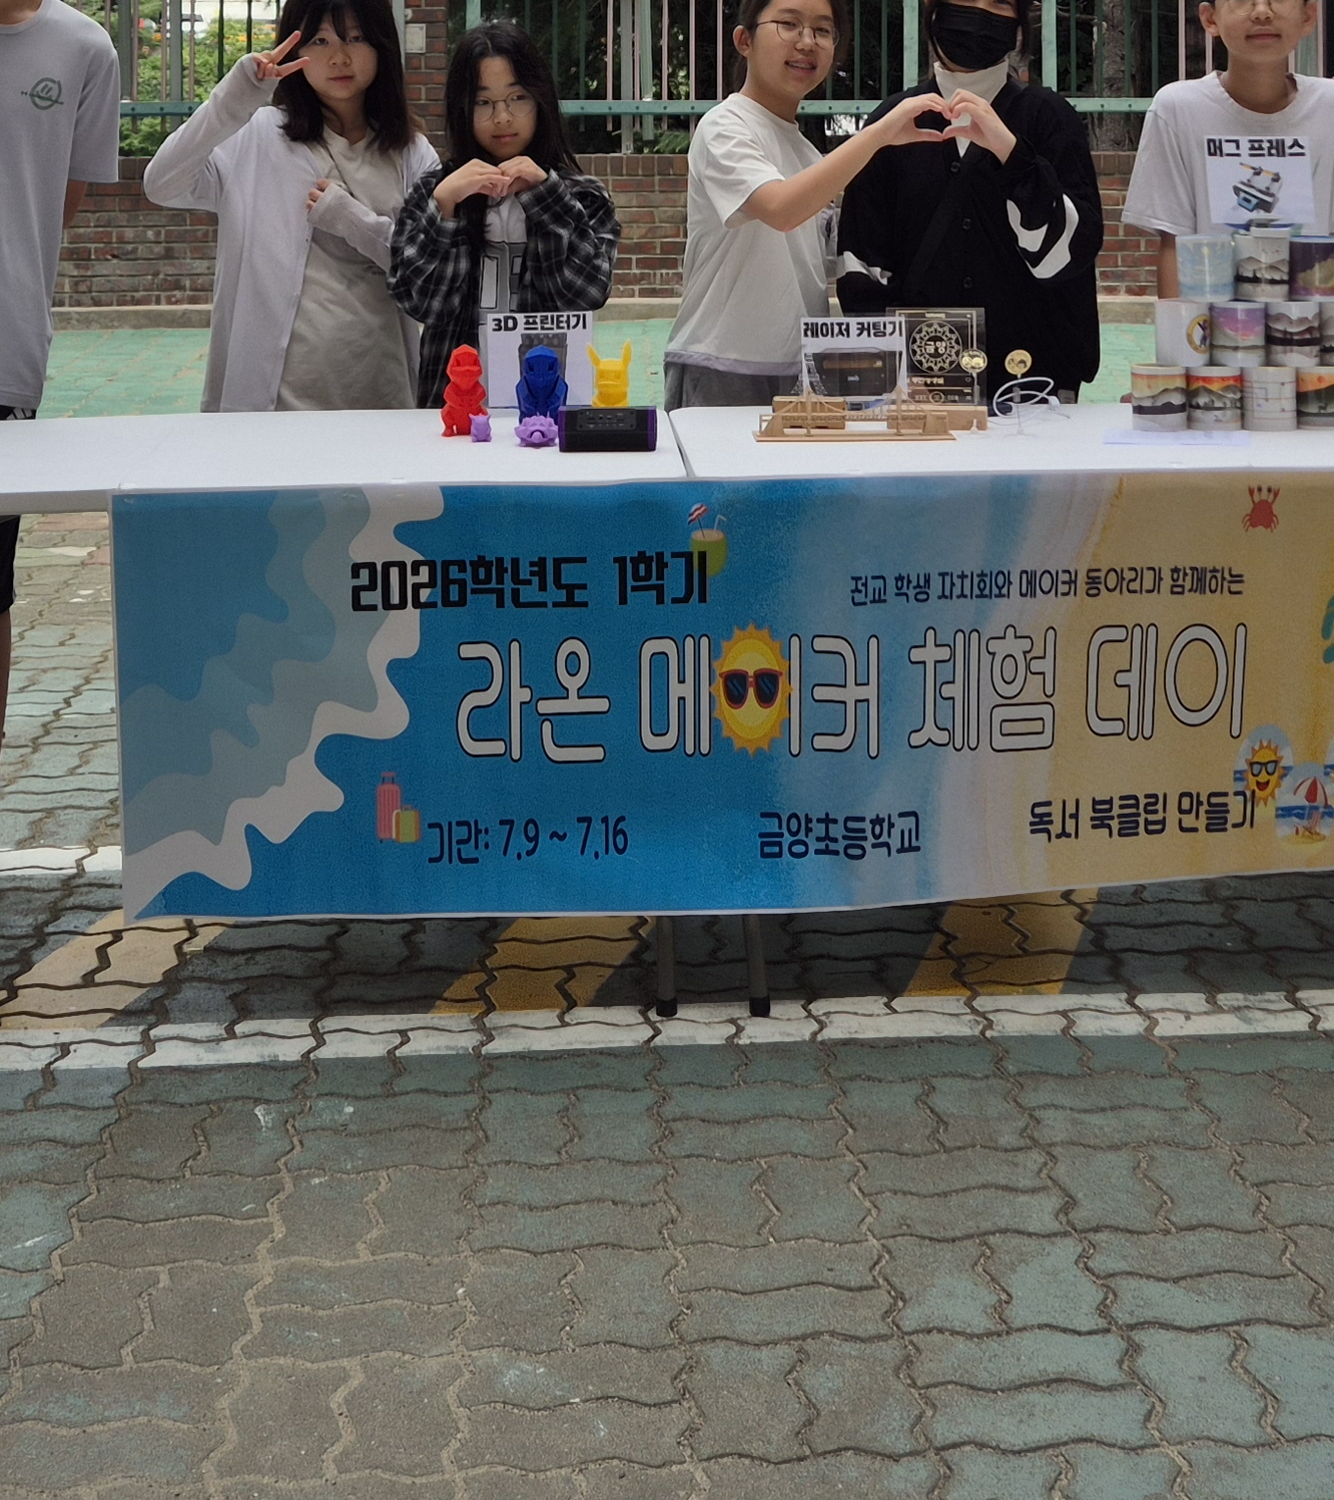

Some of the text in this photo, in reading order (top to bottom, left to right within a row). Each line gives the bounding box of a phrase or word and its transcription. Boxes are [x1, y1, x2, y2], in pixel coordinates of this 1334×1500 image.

[1207, 138, 1306, 158] 머그 프레스
[492, 313, 587, 332] 3D 프린터기
[803, 319, 903, 338] 레이저 커팅기
[349, 550, 709, 612] 2026학년도 1학기
[849, 565, 1246, 608] 전교 학생 자치회와 메이커 동아리가 함께하는
[455, 637, 612, 764] 라온
[907, 622, 1058, 753] 체험
[1084, 621, 1248, 741] 데이
[426, 814, 630, 865] 기간: 7.9 7.16
[757, 809, 922, 862] 금양초등학교
[1027, 789, 1257, 845] 독서 북클립 만들기
